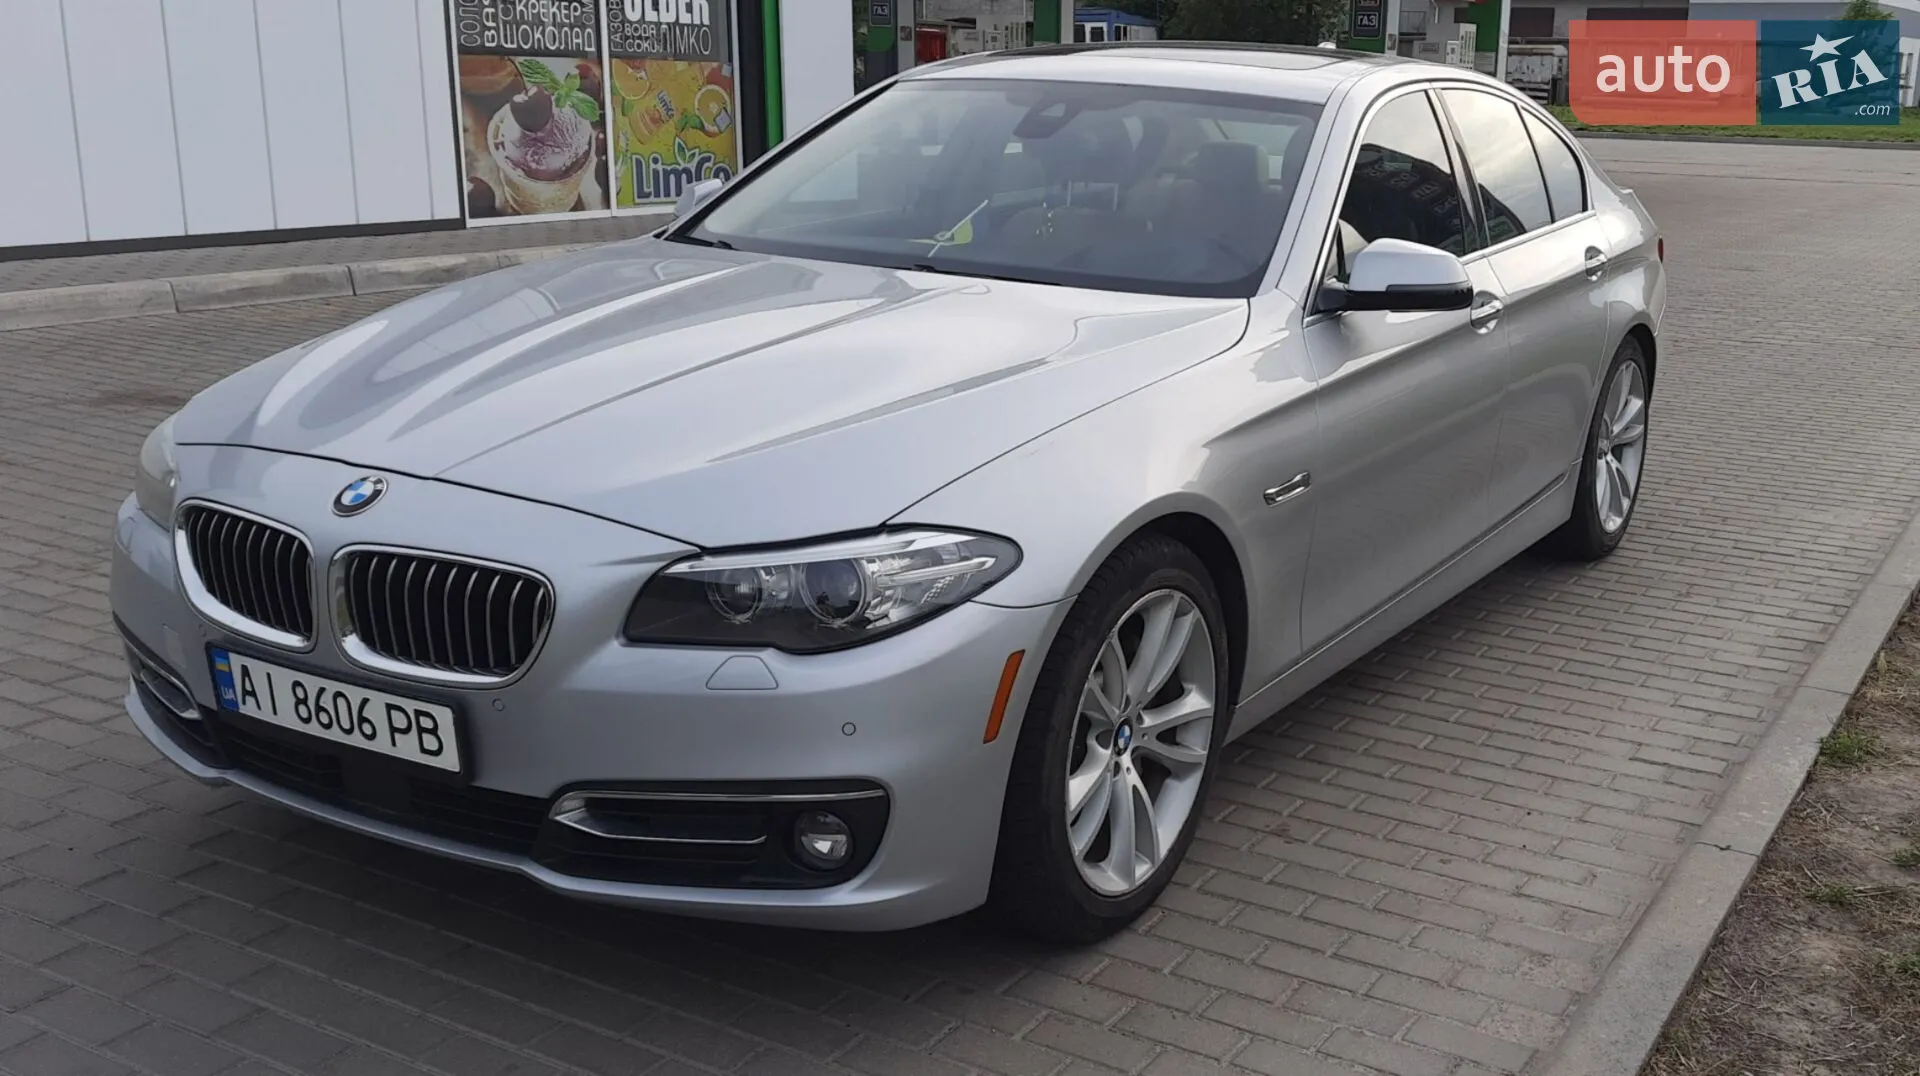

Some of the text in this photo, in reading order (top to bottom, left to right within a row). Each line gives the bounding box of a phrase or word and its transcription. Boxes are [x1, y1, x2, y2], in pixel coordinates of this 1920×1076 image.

[516, 0, 581, 23] КРЕКЕР
[1358, 15, 1376, 25] ГАЗ
[500, 22, 596, 52] ШОКОЛАД
[624, 23, 657, 37] ВОДА
[633, 153, 733, 200] LimCo
[222, 686, 236, 700] UA
[240, 663, 445, 758] AI 8606 PB
